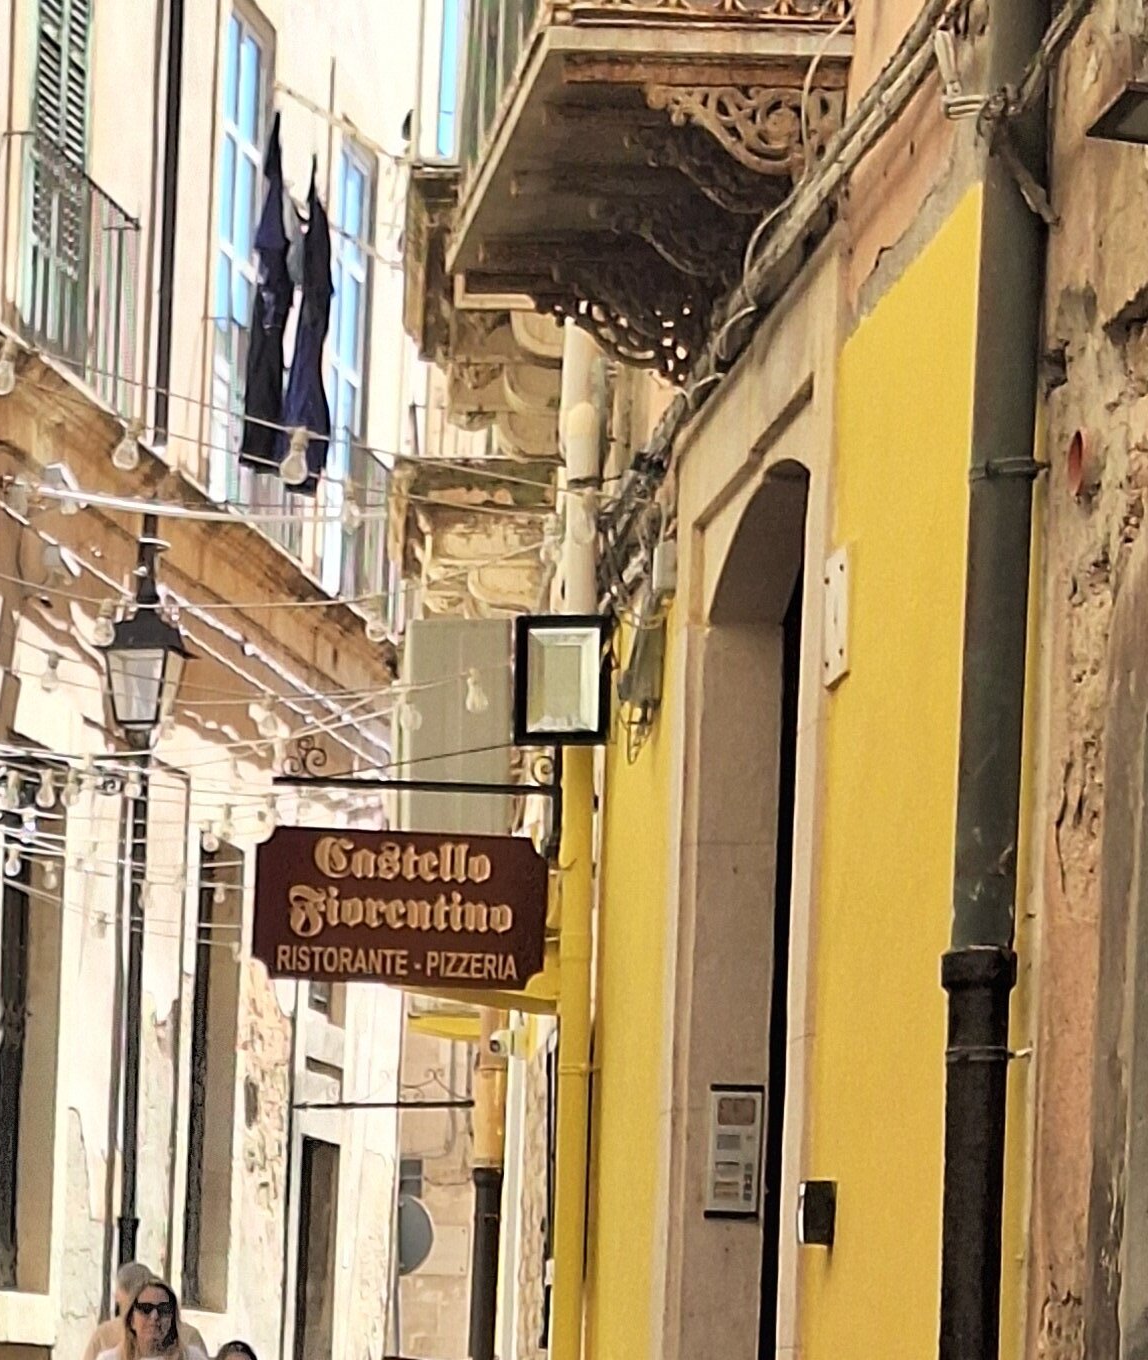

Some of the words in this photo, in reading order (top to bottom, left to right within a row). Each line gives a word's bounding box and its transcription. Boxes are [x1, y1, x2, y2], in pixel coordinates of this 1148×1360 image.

[314, 835, 492, 884] Castello
[288, 884, 514, 938] Fiorentino
[276, 944, 409, 976] RISTORANTE
[426, 950, 519, 981] PIZZERIA
